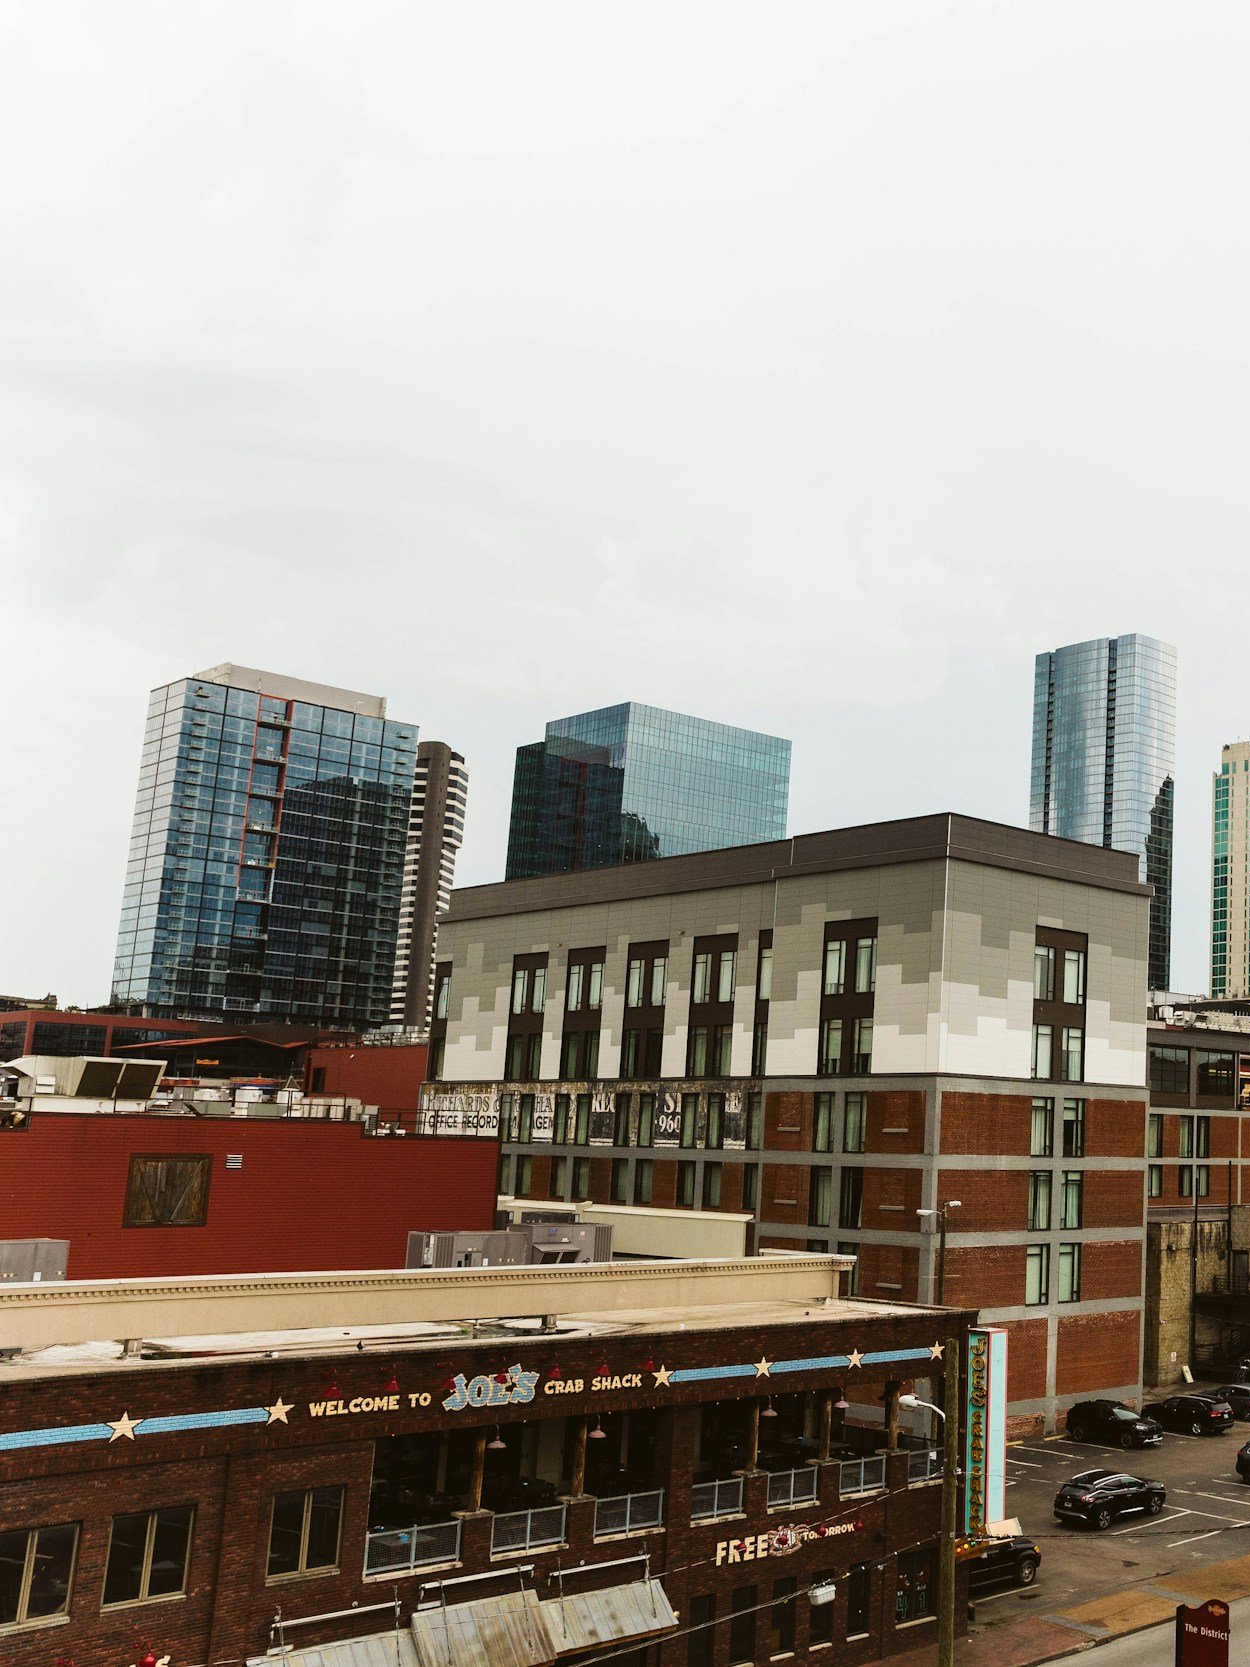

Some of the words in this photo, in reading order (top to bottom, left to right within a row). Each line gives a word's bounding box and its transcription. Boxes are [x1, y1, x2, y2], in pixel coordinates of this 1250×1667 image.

[428, 1114, 458, 1129] OFFICE
[308, 1394, 401, 1418] WELCOME
[408, 1392, 432, 1408] TO
[441, 1363, 541, 1412] JOE'S
[543, 1378, 585, 1396] CRAB
[590, 1373, 644, 1392] SHACK
[970, 1410, 983, 1463] CRAB
[969, 1465, 983, 1531] SHACK
[715, 1533, 769, 1567] FREE
[1185, 1623, 1198, 1633] The
[1200, 1626, 1228, 1641] District
